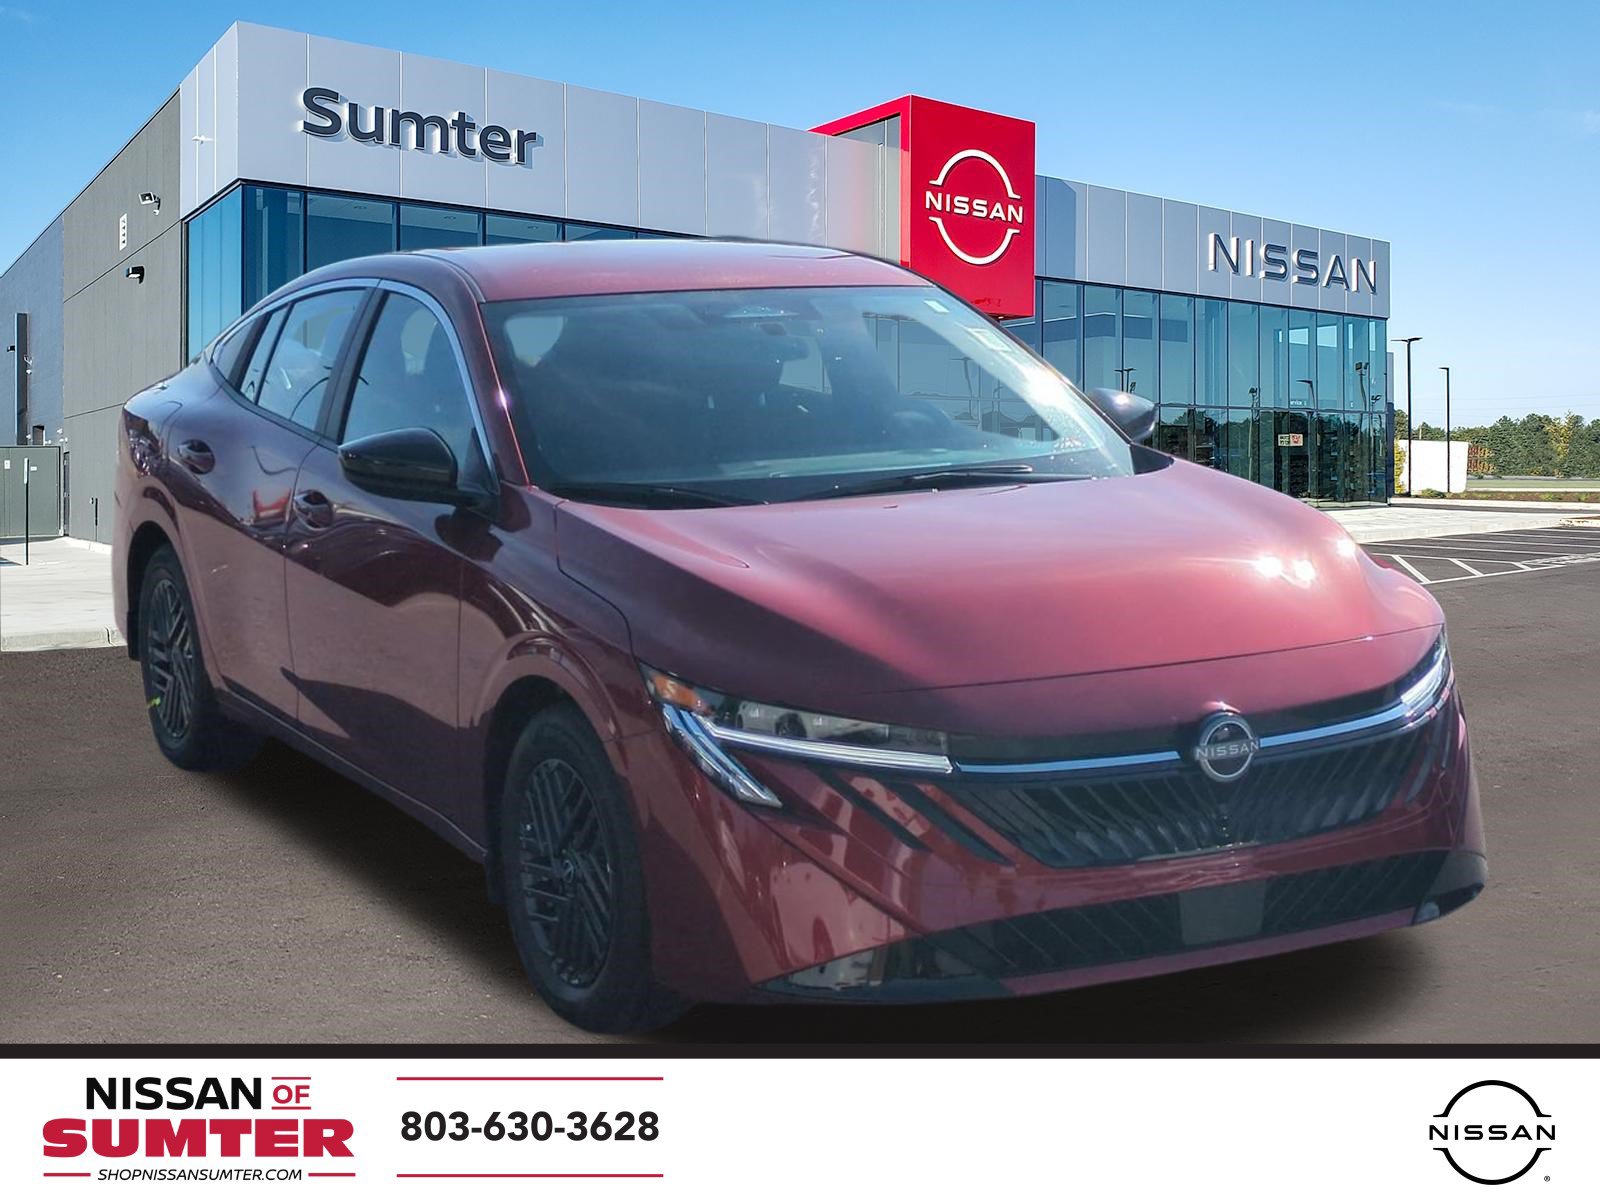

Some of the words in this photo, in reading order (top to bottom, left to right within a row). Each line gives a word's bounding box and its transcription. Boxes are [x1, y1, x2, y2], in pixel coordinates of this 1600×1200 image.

[300, 86, 538, 165] Sumter
[925, 190, 1024, 224] NISSAN
[1207, 232, 1377, 295] NISSAN
[1195, 740, 1259, 760] NISSAN
